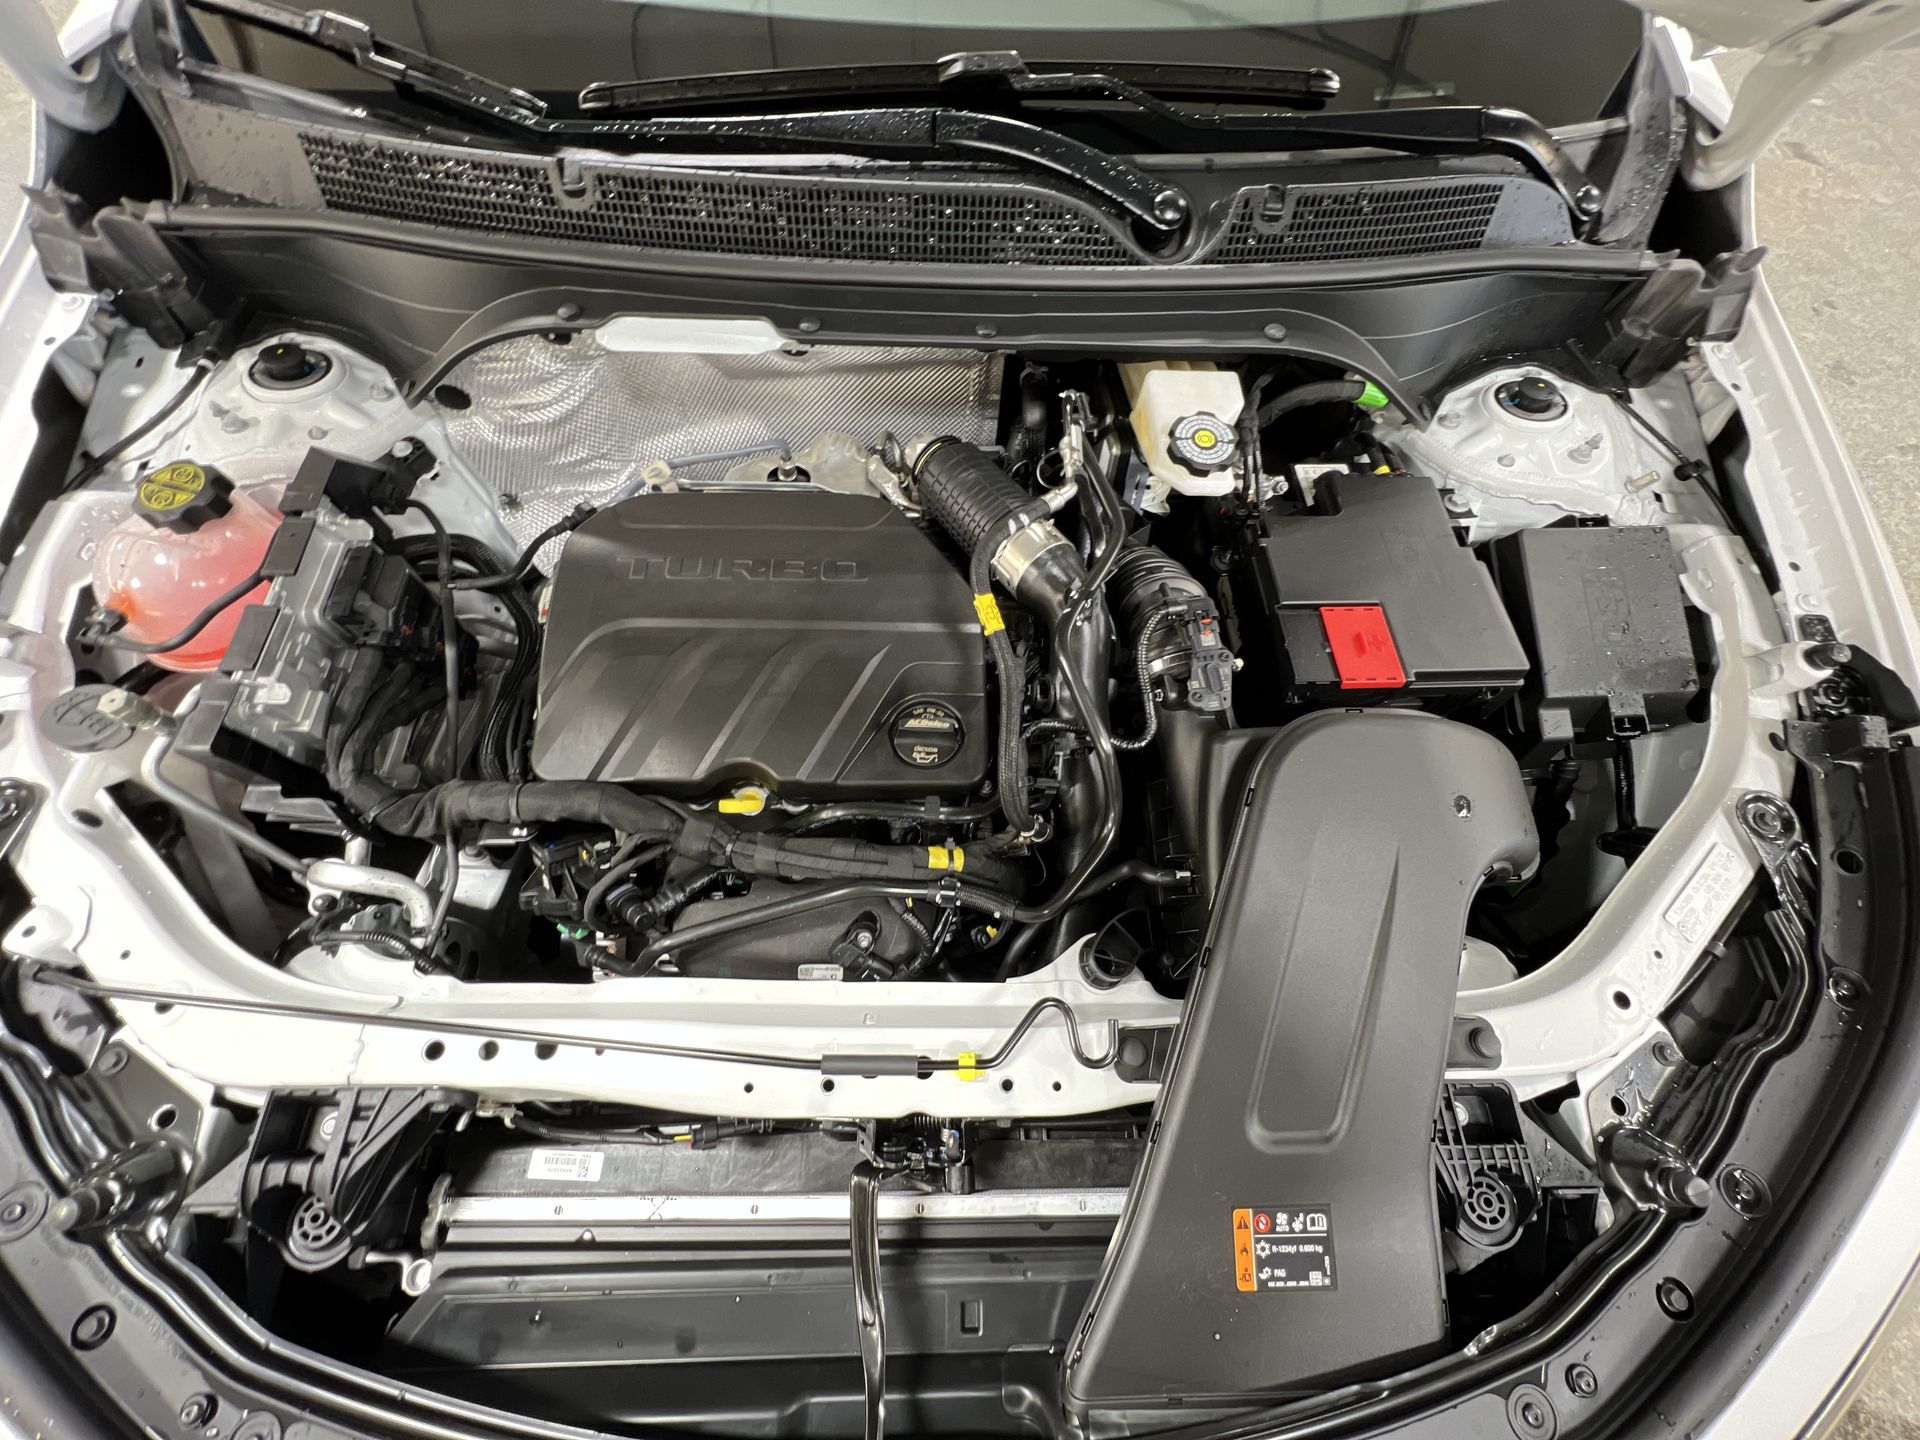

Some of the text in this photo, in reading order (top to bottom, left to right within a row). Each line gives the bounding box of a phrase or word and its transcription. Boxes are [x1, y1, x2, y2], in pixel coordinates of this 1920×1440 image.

[616, 556, 871, 582] TURBO
[904, 719, 950, 728] ACDelco
[1315, 1245, 1323, 1254] kg
